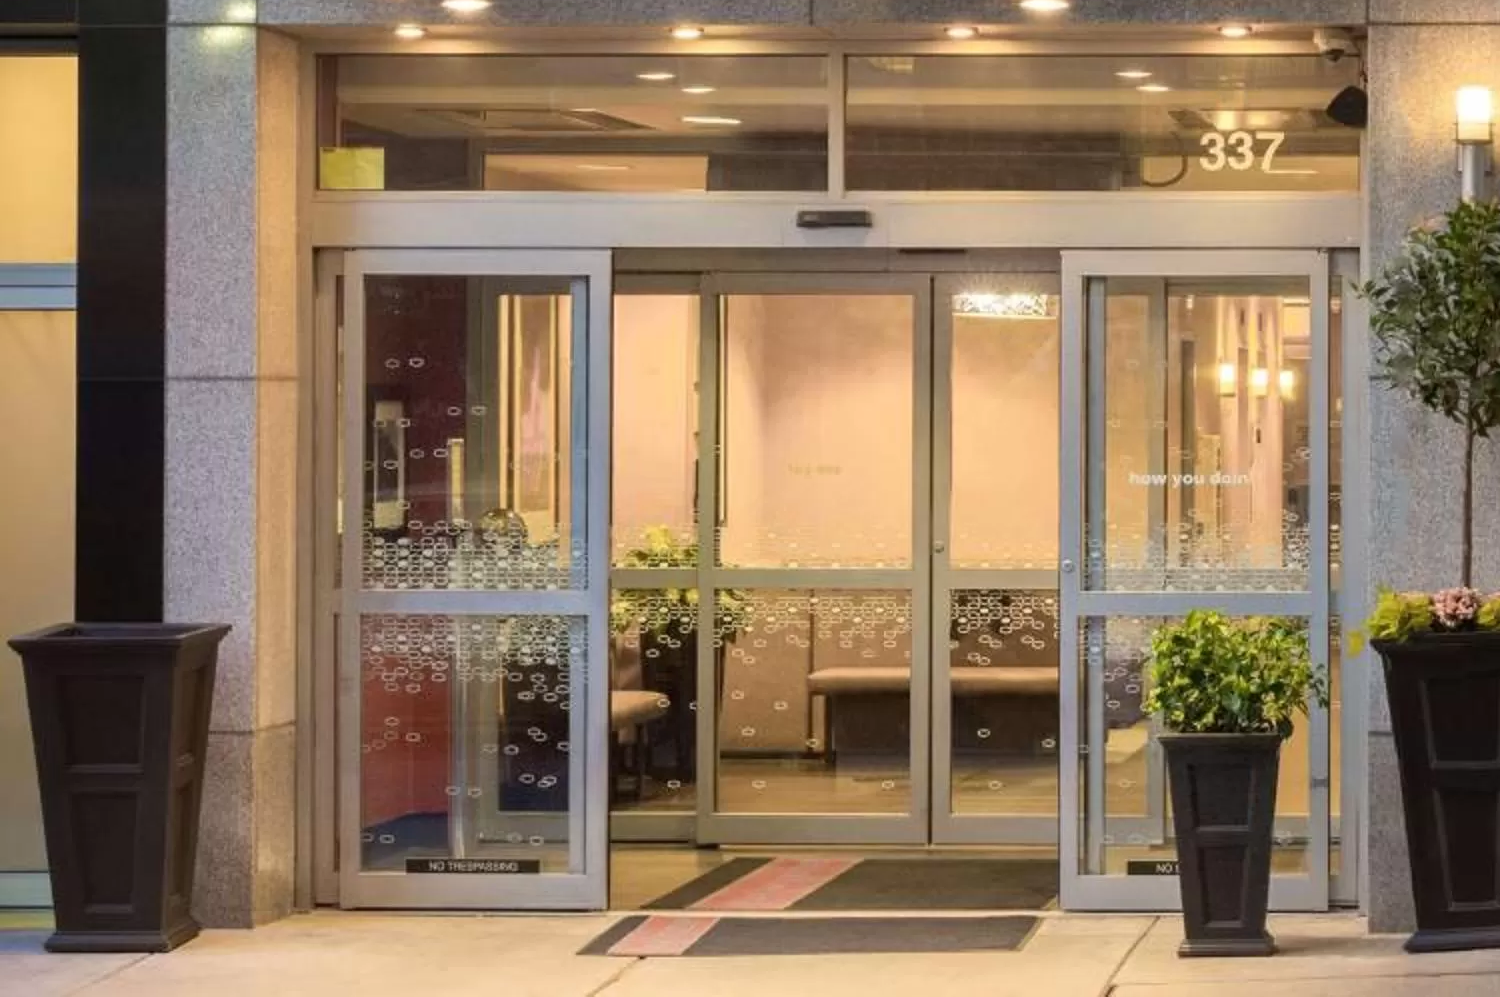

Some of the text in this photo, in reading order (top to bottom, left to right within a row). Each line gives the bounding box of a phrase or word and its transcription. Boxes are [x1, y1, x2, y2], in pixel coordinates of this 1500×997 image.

[1199, 130, 1285, 172] 337
[1171, 473, 1205, 489] you
[428, 860, 445, 872] NO
[1155, 863, 1173, 874] NO
